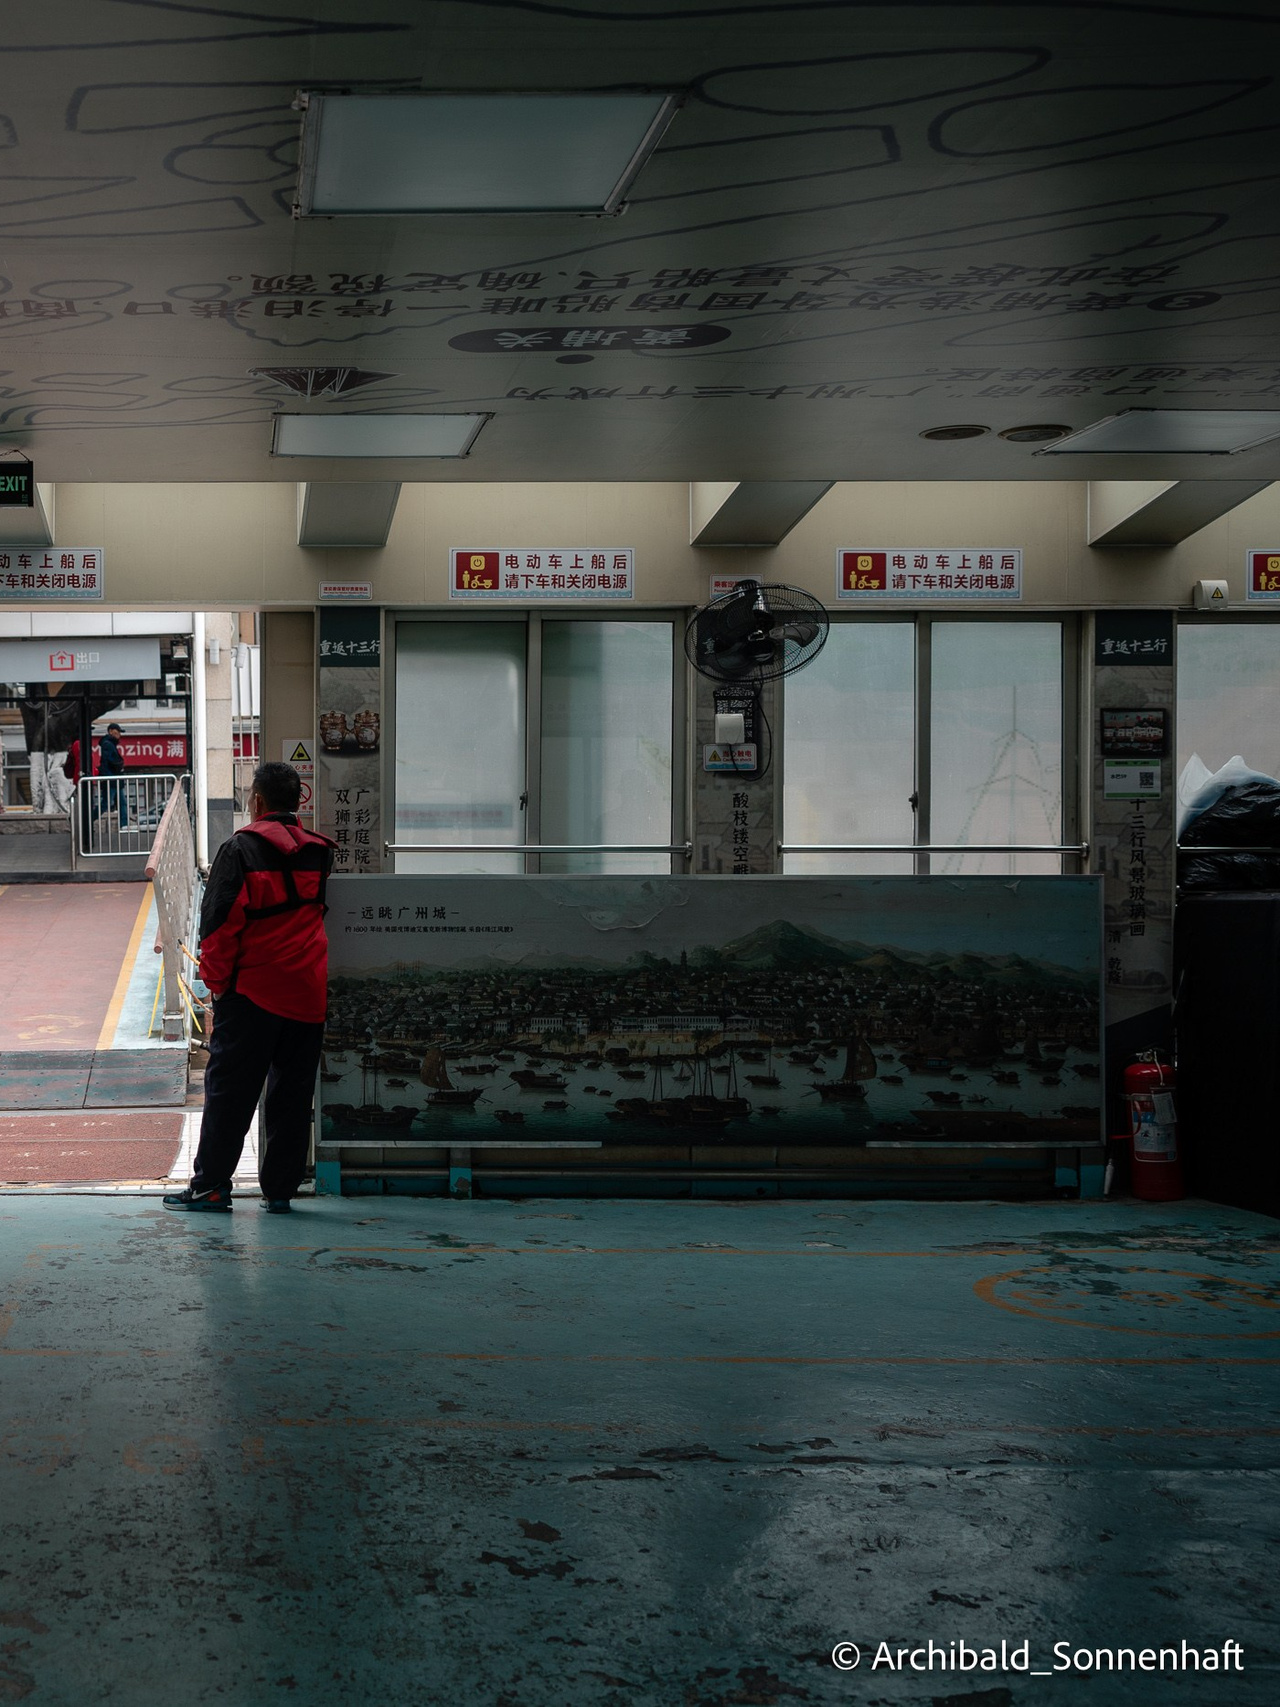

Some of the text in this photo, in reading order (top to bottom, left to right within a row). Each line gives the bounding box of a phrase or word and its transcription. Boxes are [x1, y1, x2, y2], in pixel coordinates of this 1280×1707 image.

[494, 327, 696, 348] 黄埔关
[504, 554, 627, 570] 电动车上船后
[891, 554, 1016, 570] 电动车上船后
[504, 573, 627, 590] 请下车和关闭电源
[891, 573, 1016, 590] 请下车和关闭电源
[320, 639, 381, 657] 重返十三行
[1101, 638, 1168, 655] 重返十三行
[76, 652, 100, 663] 出口
[92, 740, 184, 758] Mnzing 满
[354, 789, 370, 873] 广彩庭院
[1129, 799, 1146, 937] 十三行风景玻璃画
[361, 906, 446, 920] 远眺广州城
